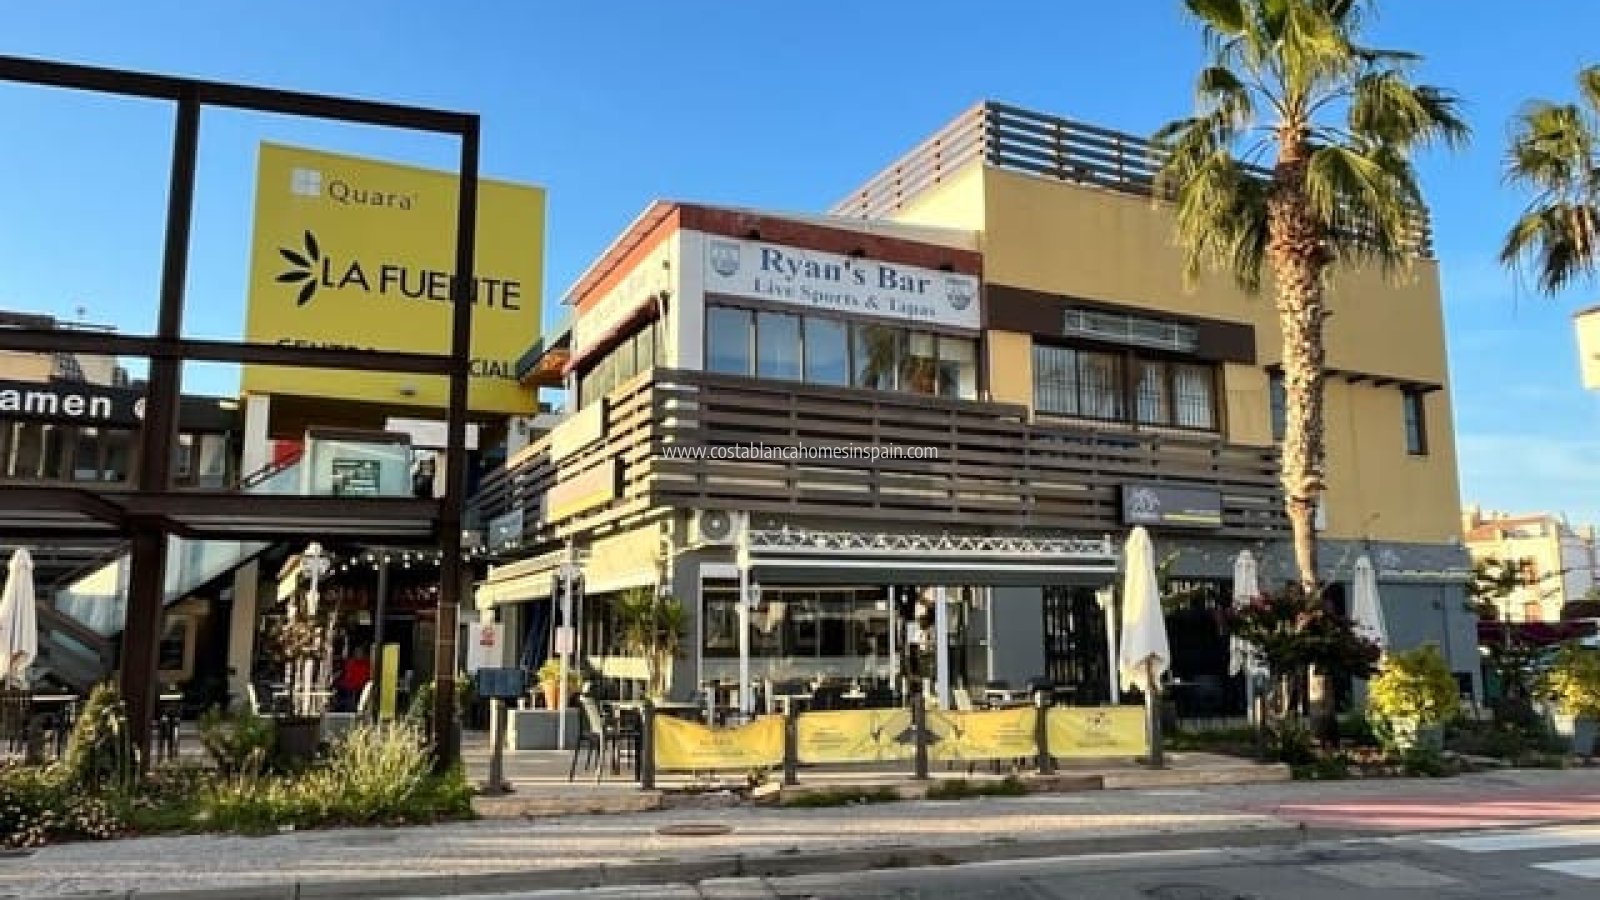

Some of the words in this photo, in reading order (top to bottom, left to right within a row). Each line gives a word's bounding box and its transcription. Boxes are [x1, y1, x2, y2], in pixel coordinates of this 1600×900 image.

[328, 180, 412, 211] Quara
[321, 256, 371, 292] LA
[760, 249, 864, 284] Ryan's
[878, 266, 931, 294] Bar
